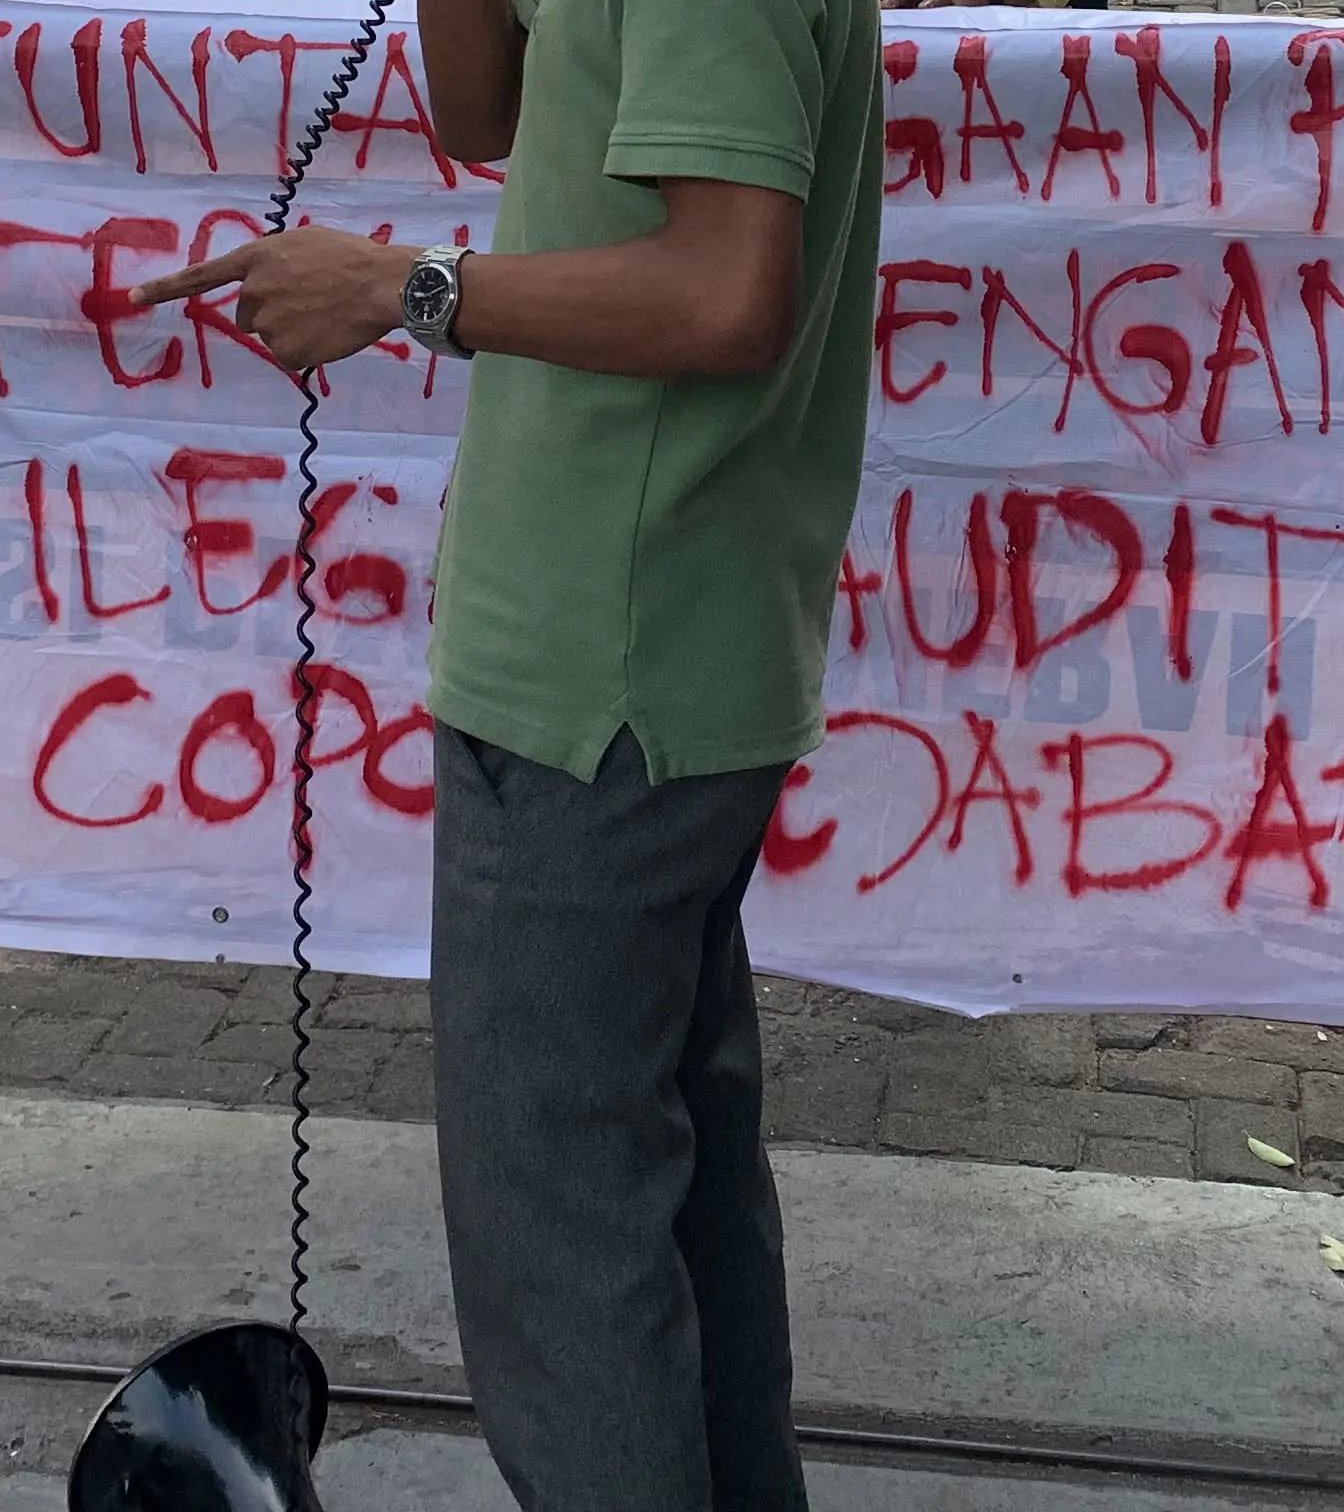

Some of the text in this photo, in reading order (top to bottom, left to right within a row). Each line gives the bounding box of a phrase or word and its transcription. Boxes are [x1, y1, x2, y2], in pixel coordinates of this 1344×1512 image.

[882, 24, 1231, 204] GAAN
[24, 443, 447, 626] ILEG
[33, 662, 435, 874] COPO
